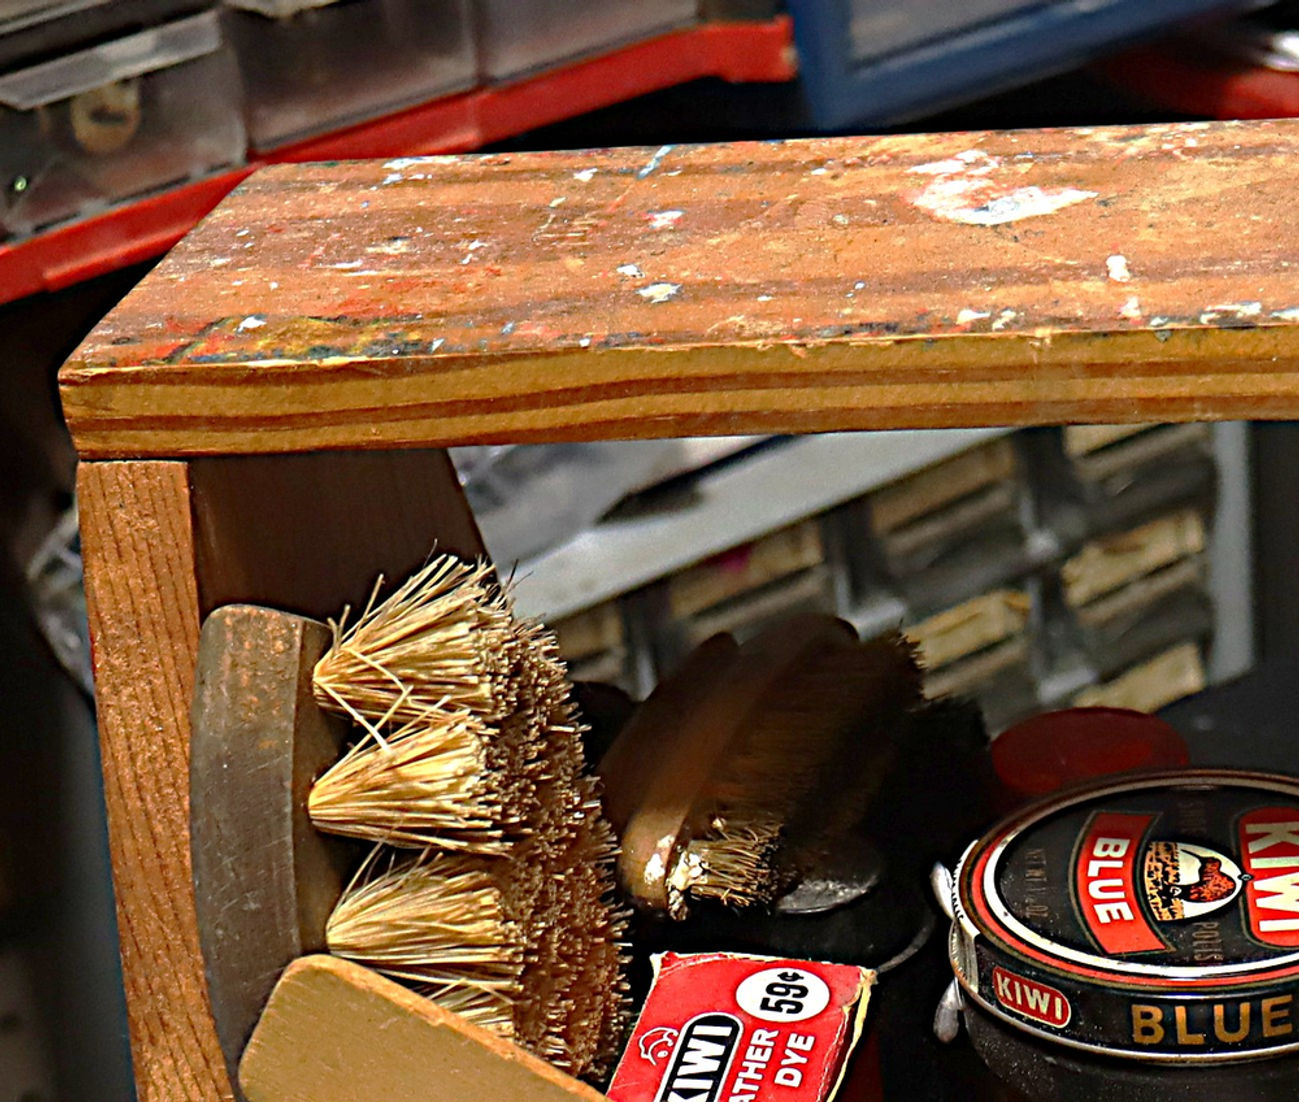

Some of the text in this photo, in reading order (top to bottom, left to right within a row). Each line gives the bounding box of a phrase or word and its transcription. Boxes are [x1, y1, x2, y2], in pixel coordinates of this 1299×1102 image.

[1085, 836, 1135, 924] BLUE
[759, 971, 810, 1015] 59¢
[996, 968, 1066, 1022] KIWI
[1130, 994, 1294, 1046] BLUE
[773, 1032, 816, 1089] DYE
